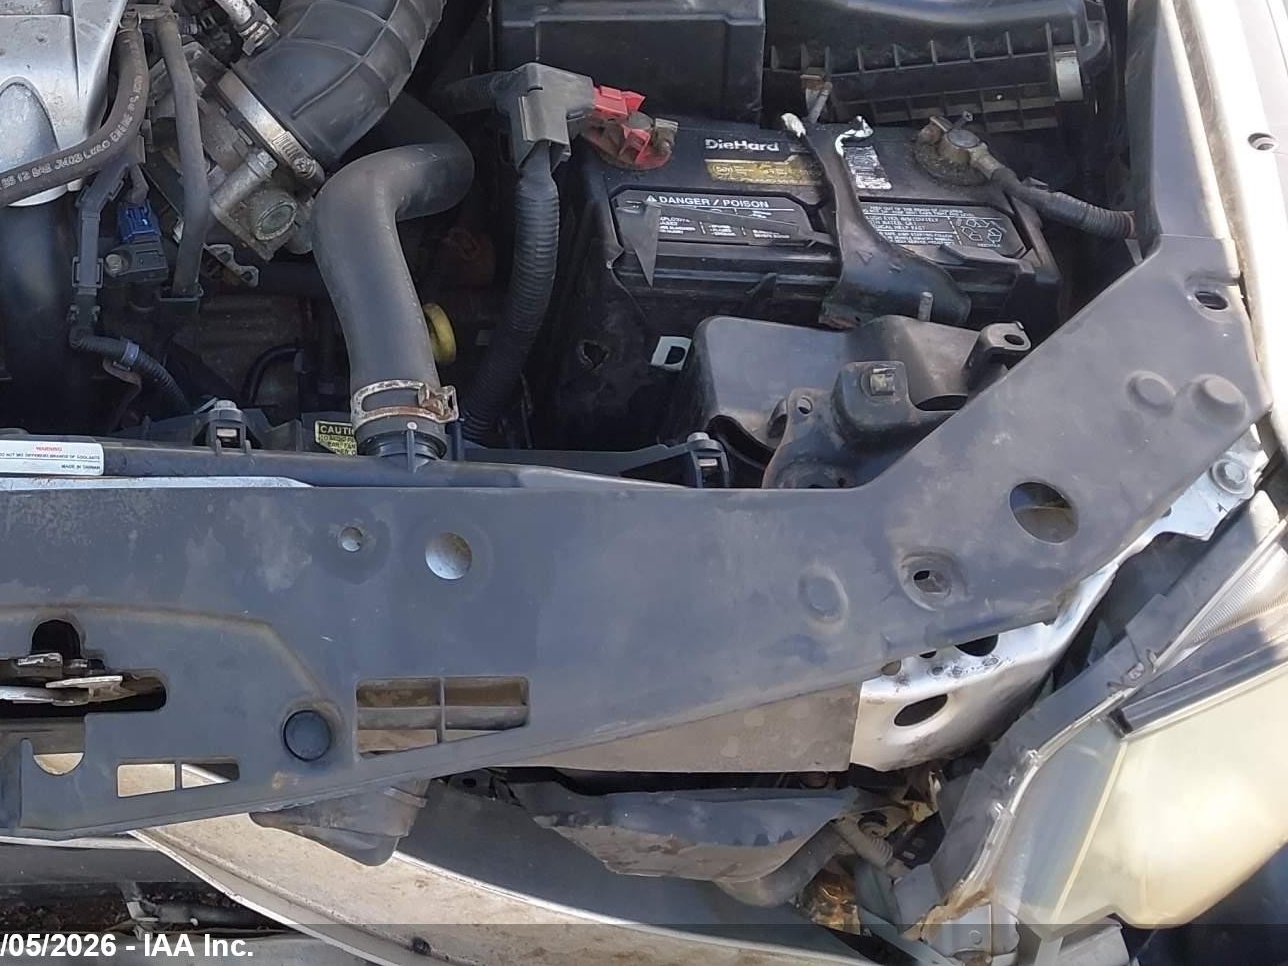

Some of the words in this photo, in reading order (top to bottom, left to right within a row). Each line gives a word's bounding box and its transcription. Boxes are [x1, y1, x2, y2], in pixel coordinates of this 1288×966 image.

[705, 139, 780, 152] DieHard
[658, 196, 710, 207] DANGER
[722, 199, 770, 209] POISON
[320, 425, 354, 435] CAUTI
